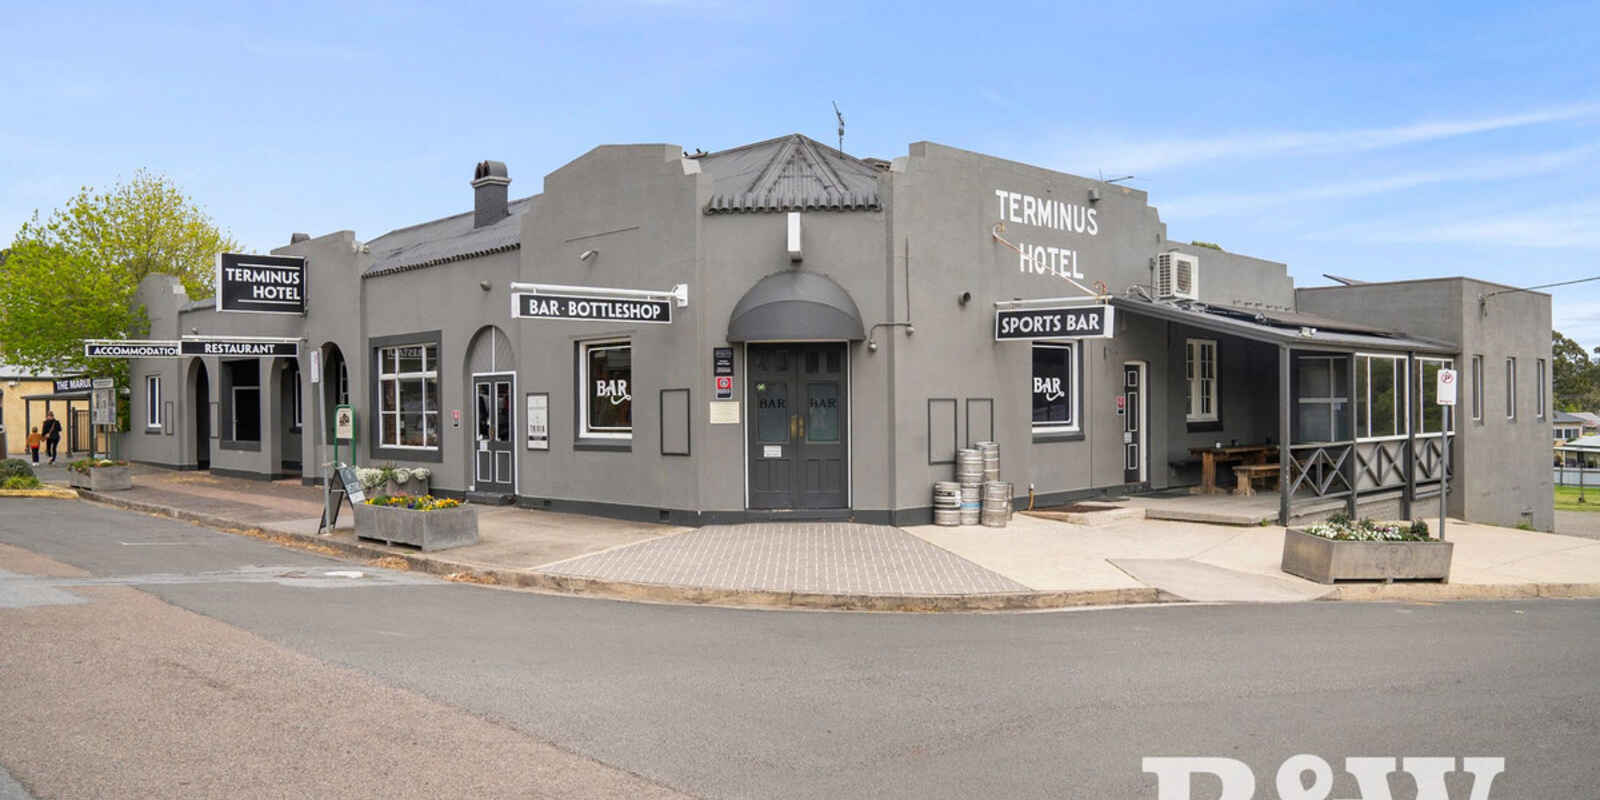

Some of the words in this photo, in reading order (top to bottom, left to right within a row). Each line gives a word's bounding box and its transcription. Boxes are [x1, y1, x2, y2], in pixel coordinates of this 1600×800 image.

[995, 189, 1098, 235] TERMINUS
[1020, 243, 1084, 279] HOTEL
[225, 267, 300, 284] TERMINUS
[252, 286, 300, 300] HOTEL
[529, 299, 560, 316] BAR
[568, 302, 661, 319] BOTTLESHOP
[1001, 315, 1061, 333] SPORTS
[1066, 313, 1100, 330] BAR
[204, 343, 275, 353] RESTAURANT
[596, 379, 632, 405] BAR
[1033, 376, 1065, 401] BAR
[760, 398, 785, 409] BAR
[810, 398, 836, 409] BAR
